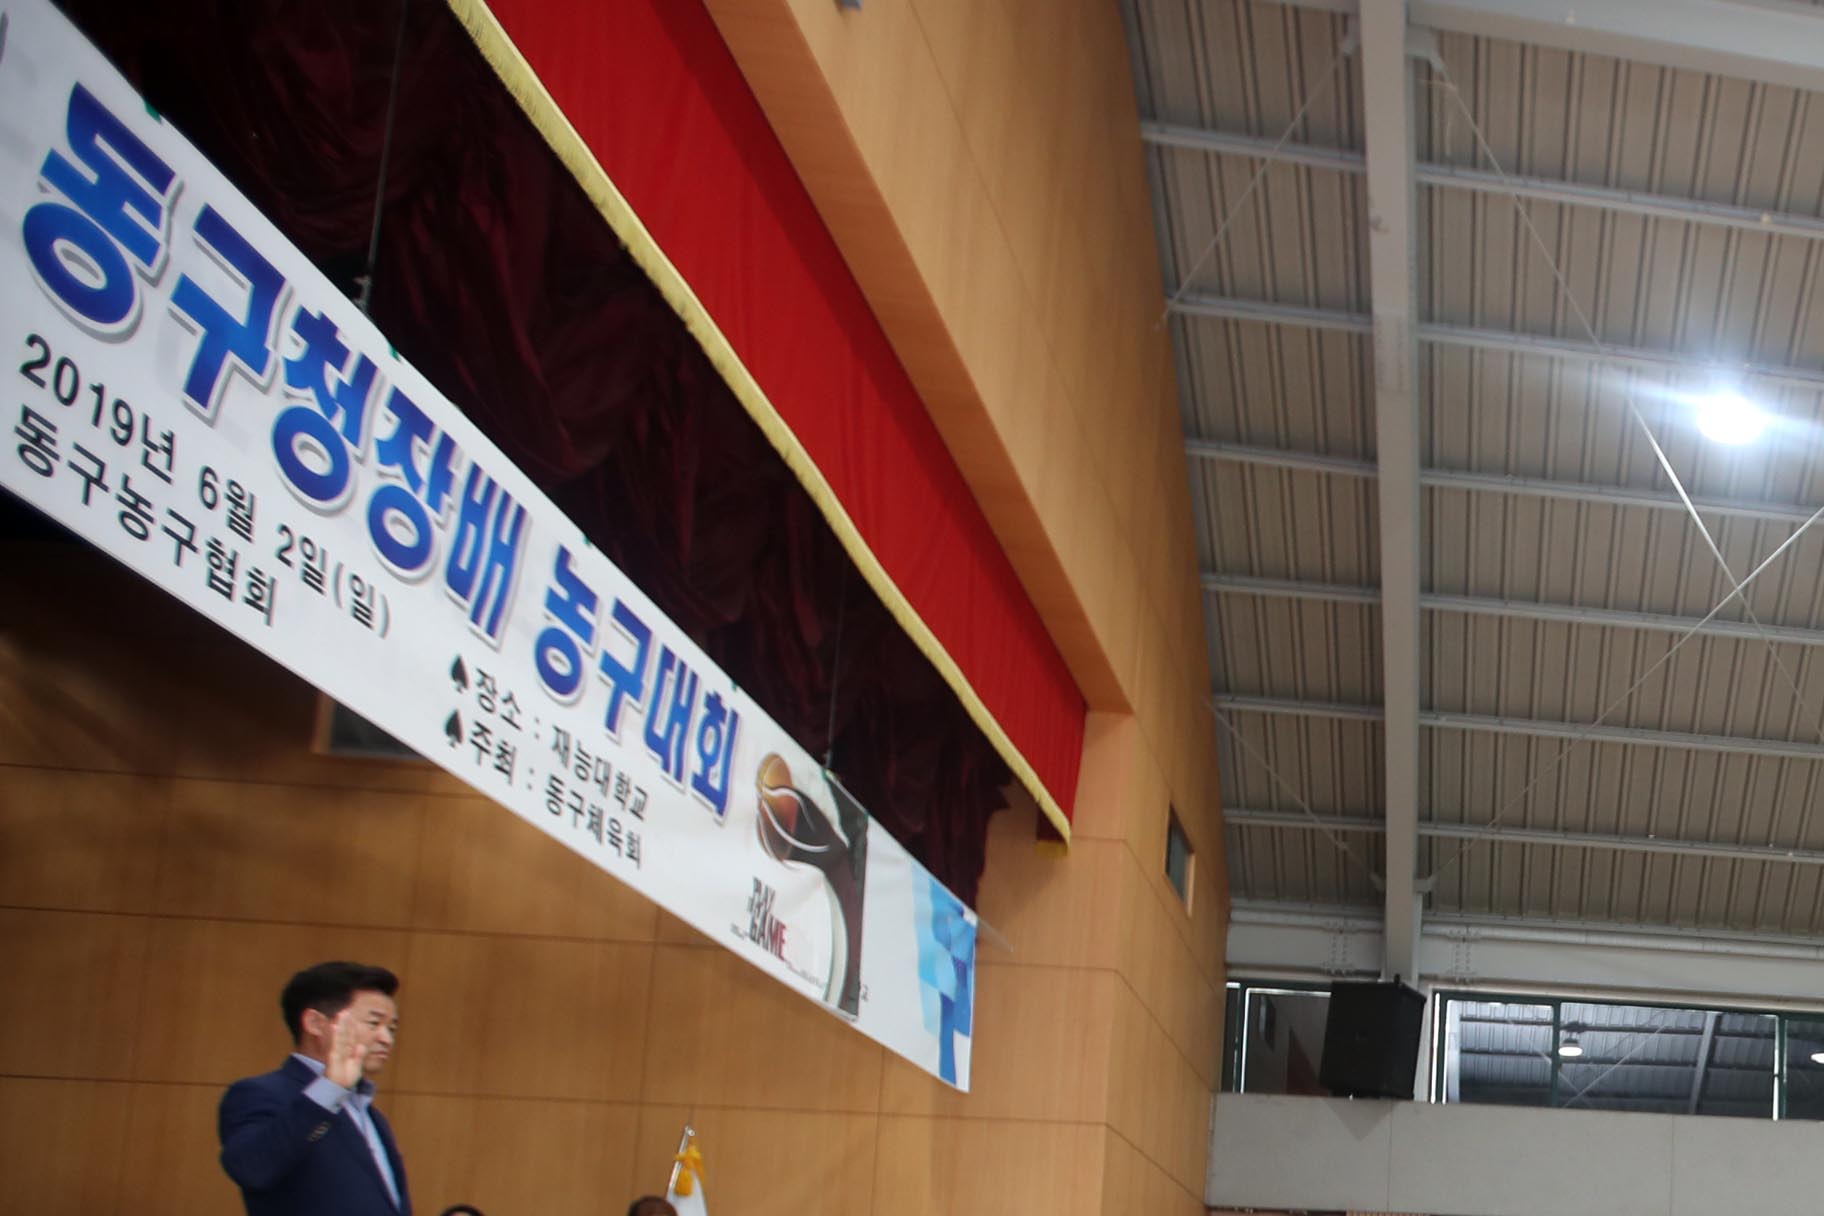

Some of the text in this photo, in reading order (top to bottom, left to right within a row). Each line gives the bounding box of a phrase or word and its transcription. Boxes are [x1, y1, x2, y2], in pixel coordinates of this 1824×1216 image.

[14, 404, 277, 627] 동구농구협회
[19, 333, 390, 639] 2019년 6월 2일(일)
[22, 80, 740, 820] 동구청장배 농구대회
[469, 720, 515, 786] 주최
[545, 774, 641, 869] 동구체육회
[475, 667, 522, 732] 장소
[551, 725, 648, 821] 재능대학교
